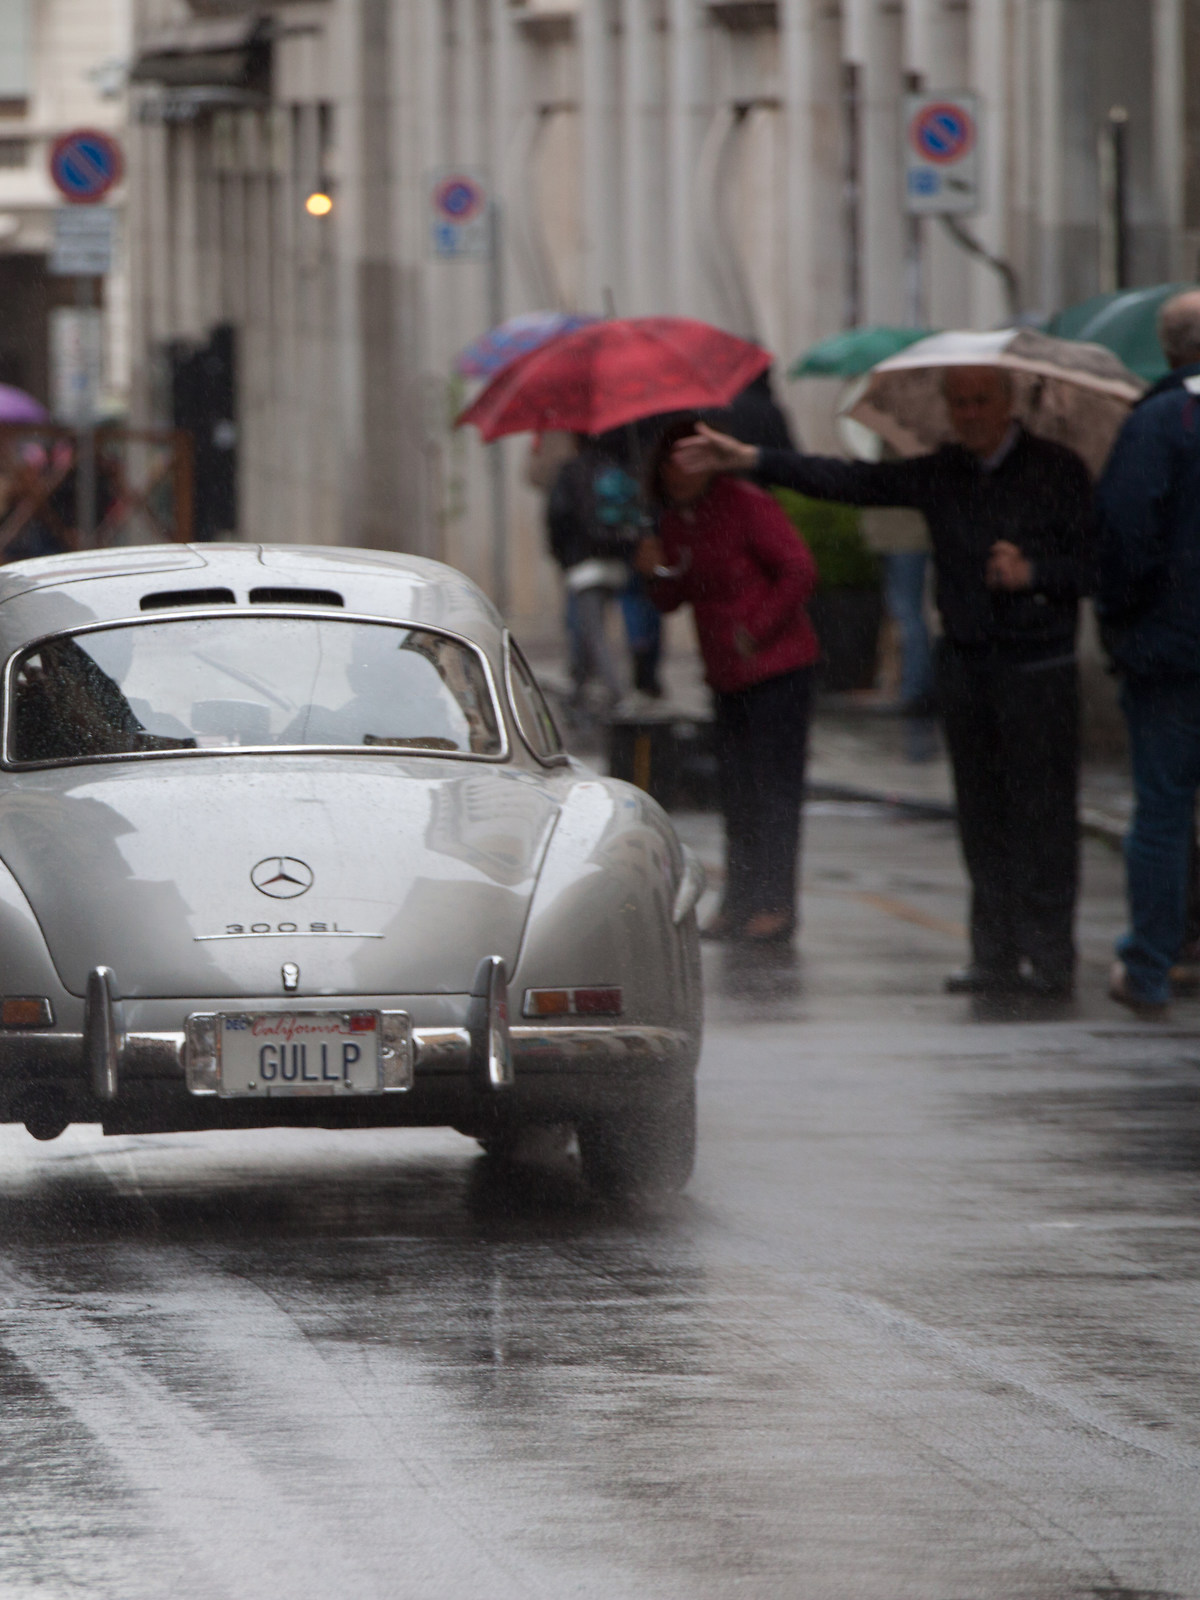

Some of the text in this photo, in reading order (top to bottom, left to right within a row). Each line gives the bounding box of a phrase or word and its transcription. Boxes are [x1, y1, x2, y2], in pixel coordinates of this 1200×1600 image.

[226, 922, 353, 934] 300 SL
[225, 1019, 248, 1030] DEC
[252, 1017, 364, 1041] California
[259, 1043, 360, 1081] GULLP
